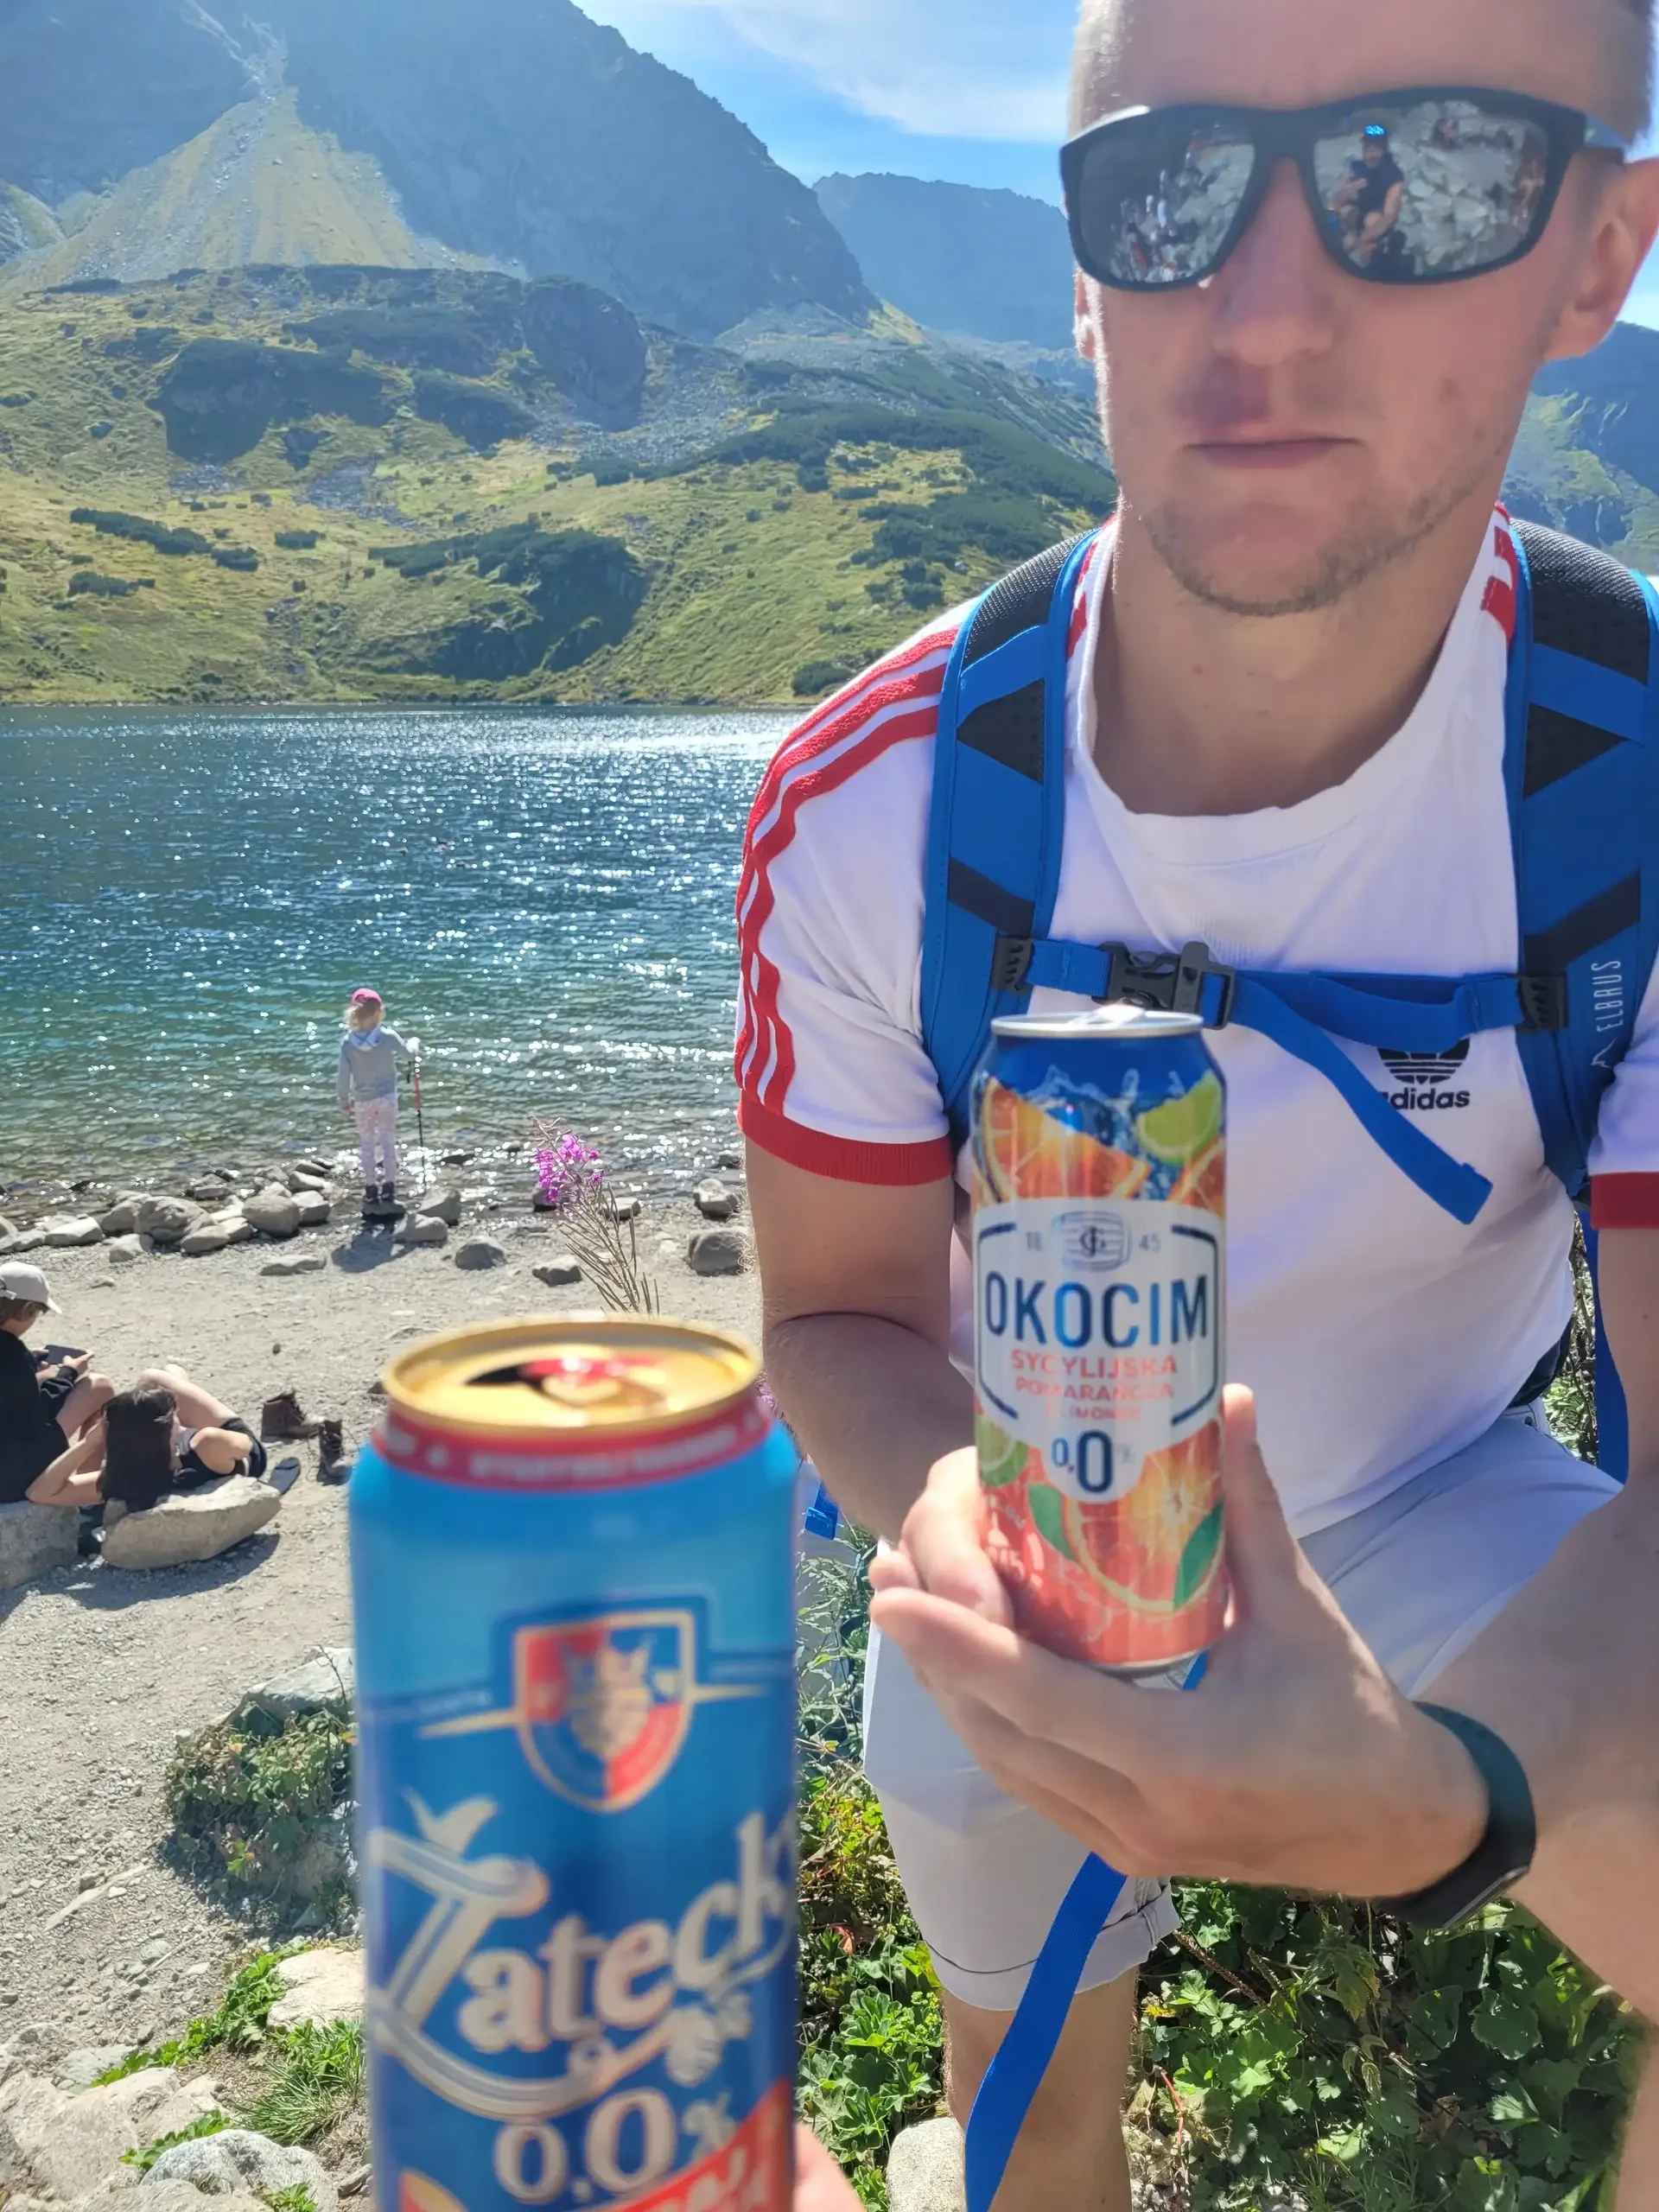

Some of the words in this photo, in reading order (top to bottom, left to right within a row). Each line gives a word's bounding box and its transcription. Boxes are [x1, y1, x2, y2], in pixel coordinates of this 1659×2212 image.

[1591, 960, 1624, 1033] ELBRUS
[1379, 1087, 1471, 1110] didas
[985, 1271, 1207, 1349] OKOCIM
[1011, 1349, 1178, 1380] SYCYLIJSKA
